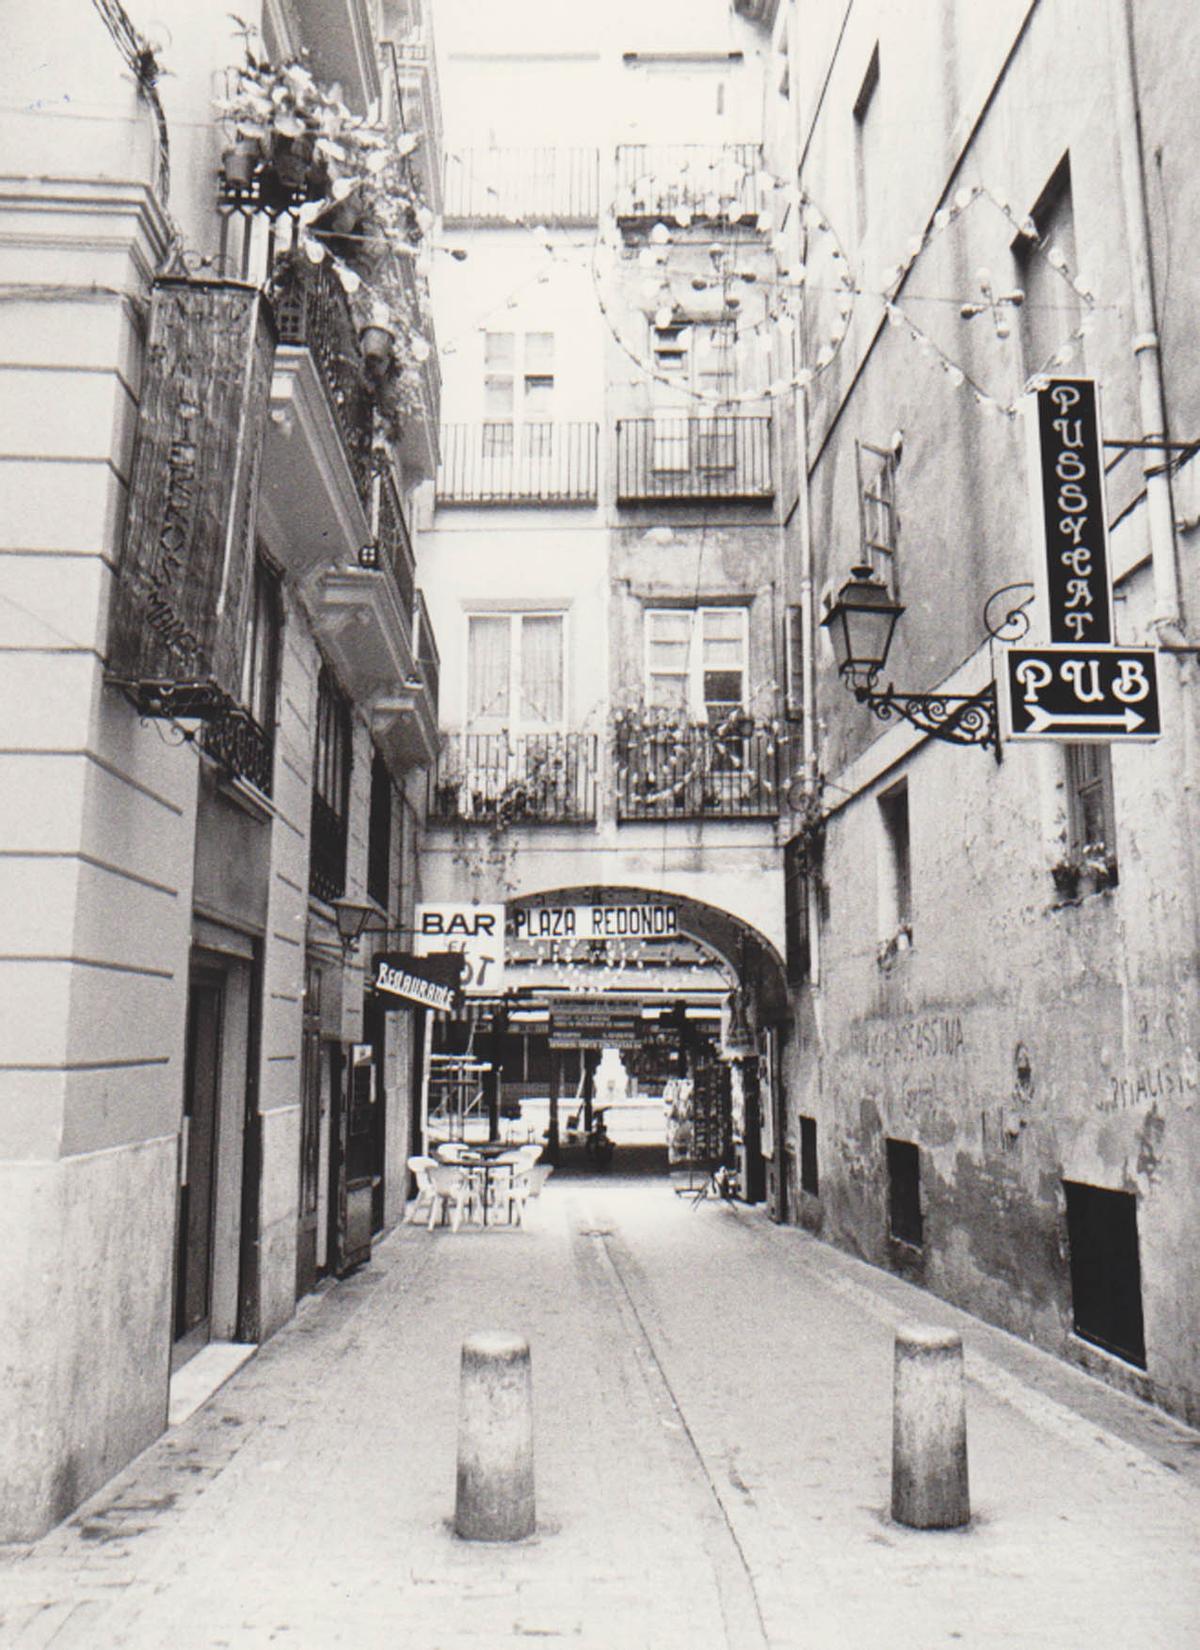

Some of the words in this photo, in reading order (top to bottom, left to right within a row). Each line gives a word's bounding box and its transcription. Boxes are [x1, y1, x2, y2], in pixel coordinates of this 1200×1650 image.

[1050, 386, 1093, 641] PUSSYCAT
[1015, 659, 1150, 703] PUB
[422, 913, 497, 936] BAR
[514, 909, 577, 937] PLAZA
[593, 905, 678, 935] REDONDA
